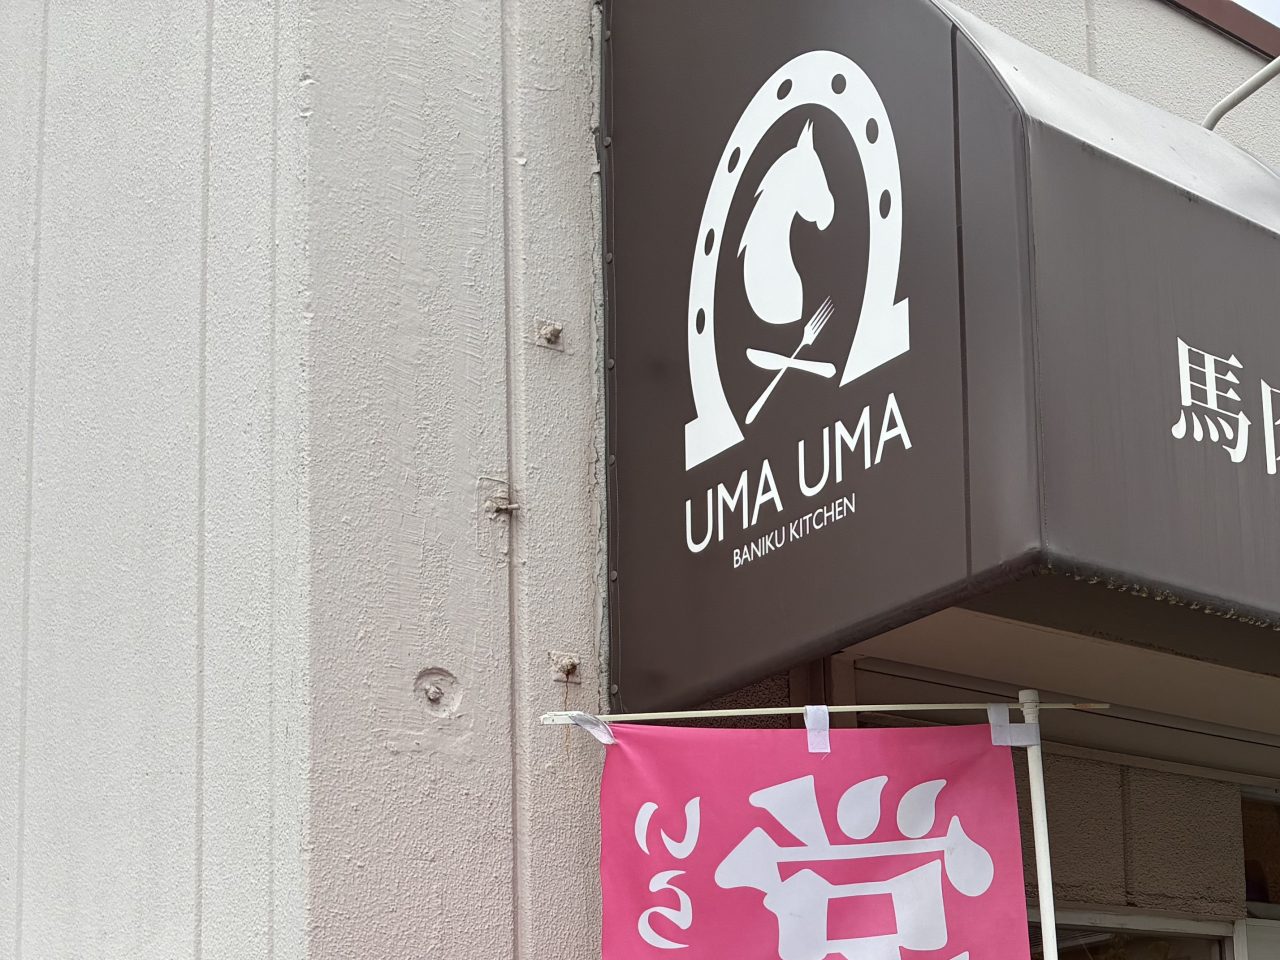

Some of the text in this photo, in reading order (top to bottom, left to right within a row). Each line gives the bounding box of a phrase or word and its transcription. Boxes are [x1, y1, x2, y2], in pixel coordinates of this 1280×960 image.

[685, 392, 912, 554] UMA UMA
[732, 493, 856, 569] BANIKU KITCHEN
